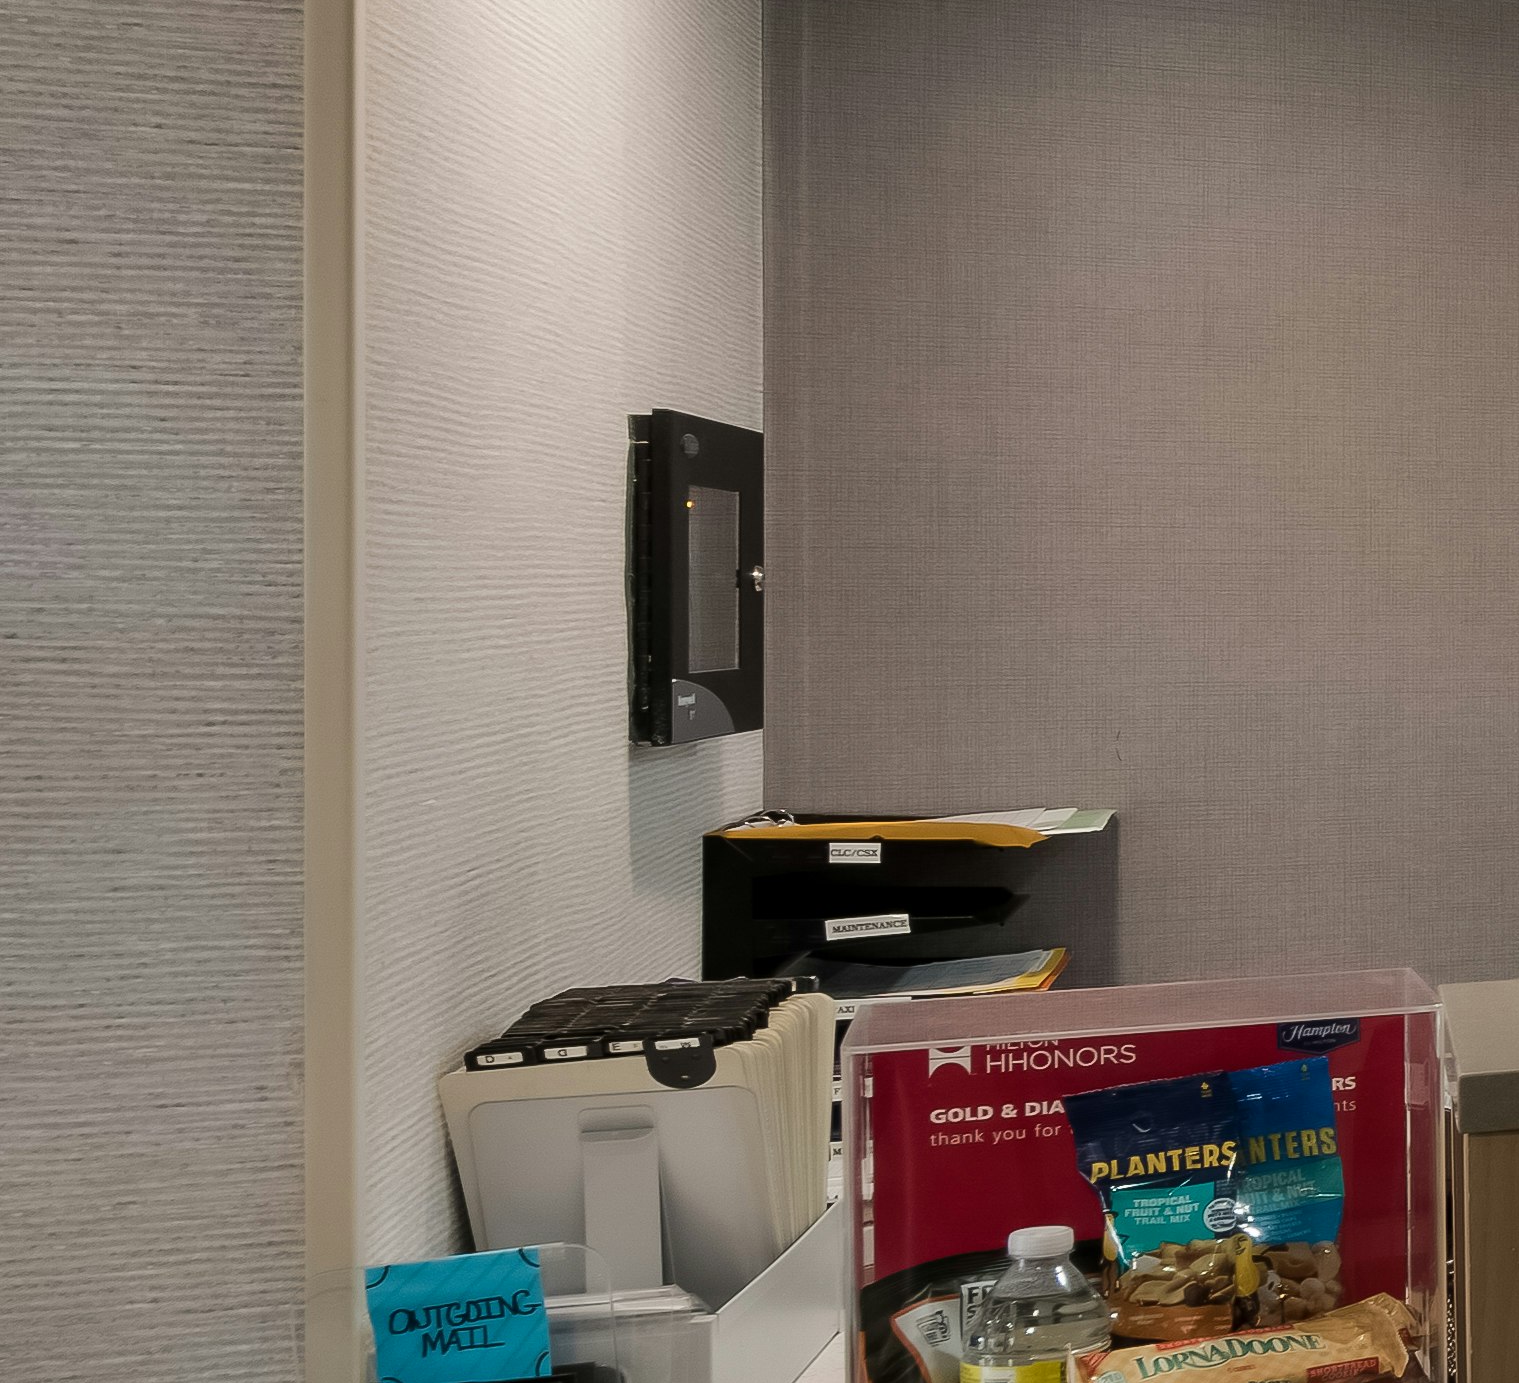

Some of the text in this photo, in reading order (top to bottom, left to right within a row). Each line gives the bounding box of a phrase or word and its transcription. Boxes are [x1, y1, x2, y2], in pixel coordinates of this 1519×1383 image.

[832, 919, 908, 933] MAINTENANCE
[1282, 1023, 1357, 1042] Hampton
[986, 1044, 1137, 1074] HHONORS
[929, 1105, 994, 1124] GOLD
[1001, 1104, 1018, 1118] &
[930, 1124, 1062, 1147] thank you for
[1090, 1141, 1238, 1184] PLANTERS
[1124, 1202, 1200, 1217] FRUIT & NUT
[1133, 1195, 1192, 1207] TROPICAL
[1134, 1214, 1191, 1225] TRAIL MIX
[388, 1289, 542, 1335] OUTGOING
[421, 1324, 506, 1358] MAIL
